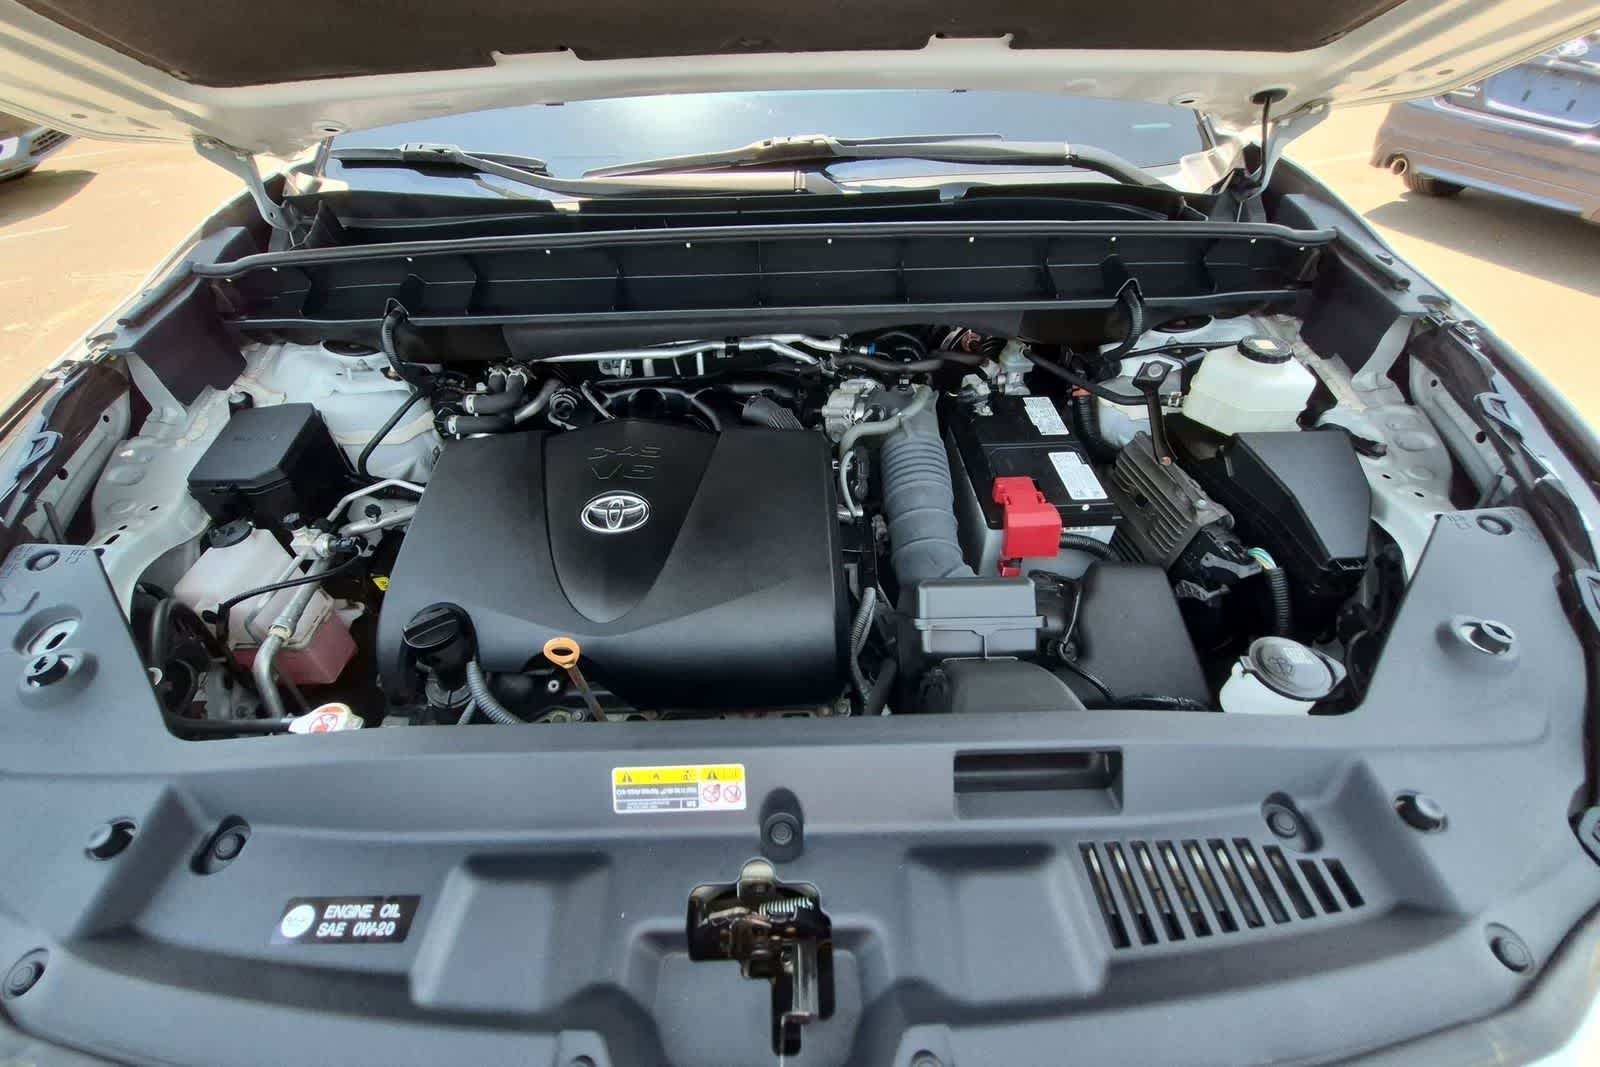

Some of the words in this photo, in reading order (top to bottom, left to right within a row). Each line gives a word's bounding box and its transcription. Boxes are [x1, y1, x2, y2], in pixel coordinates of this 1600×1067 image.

[323, 904, 375, 919] ENGINE
[379, 903, 401, 918] OIL
[316, 921, 347, 937] SAE
[352, 921, 396, 937] 0W-20
